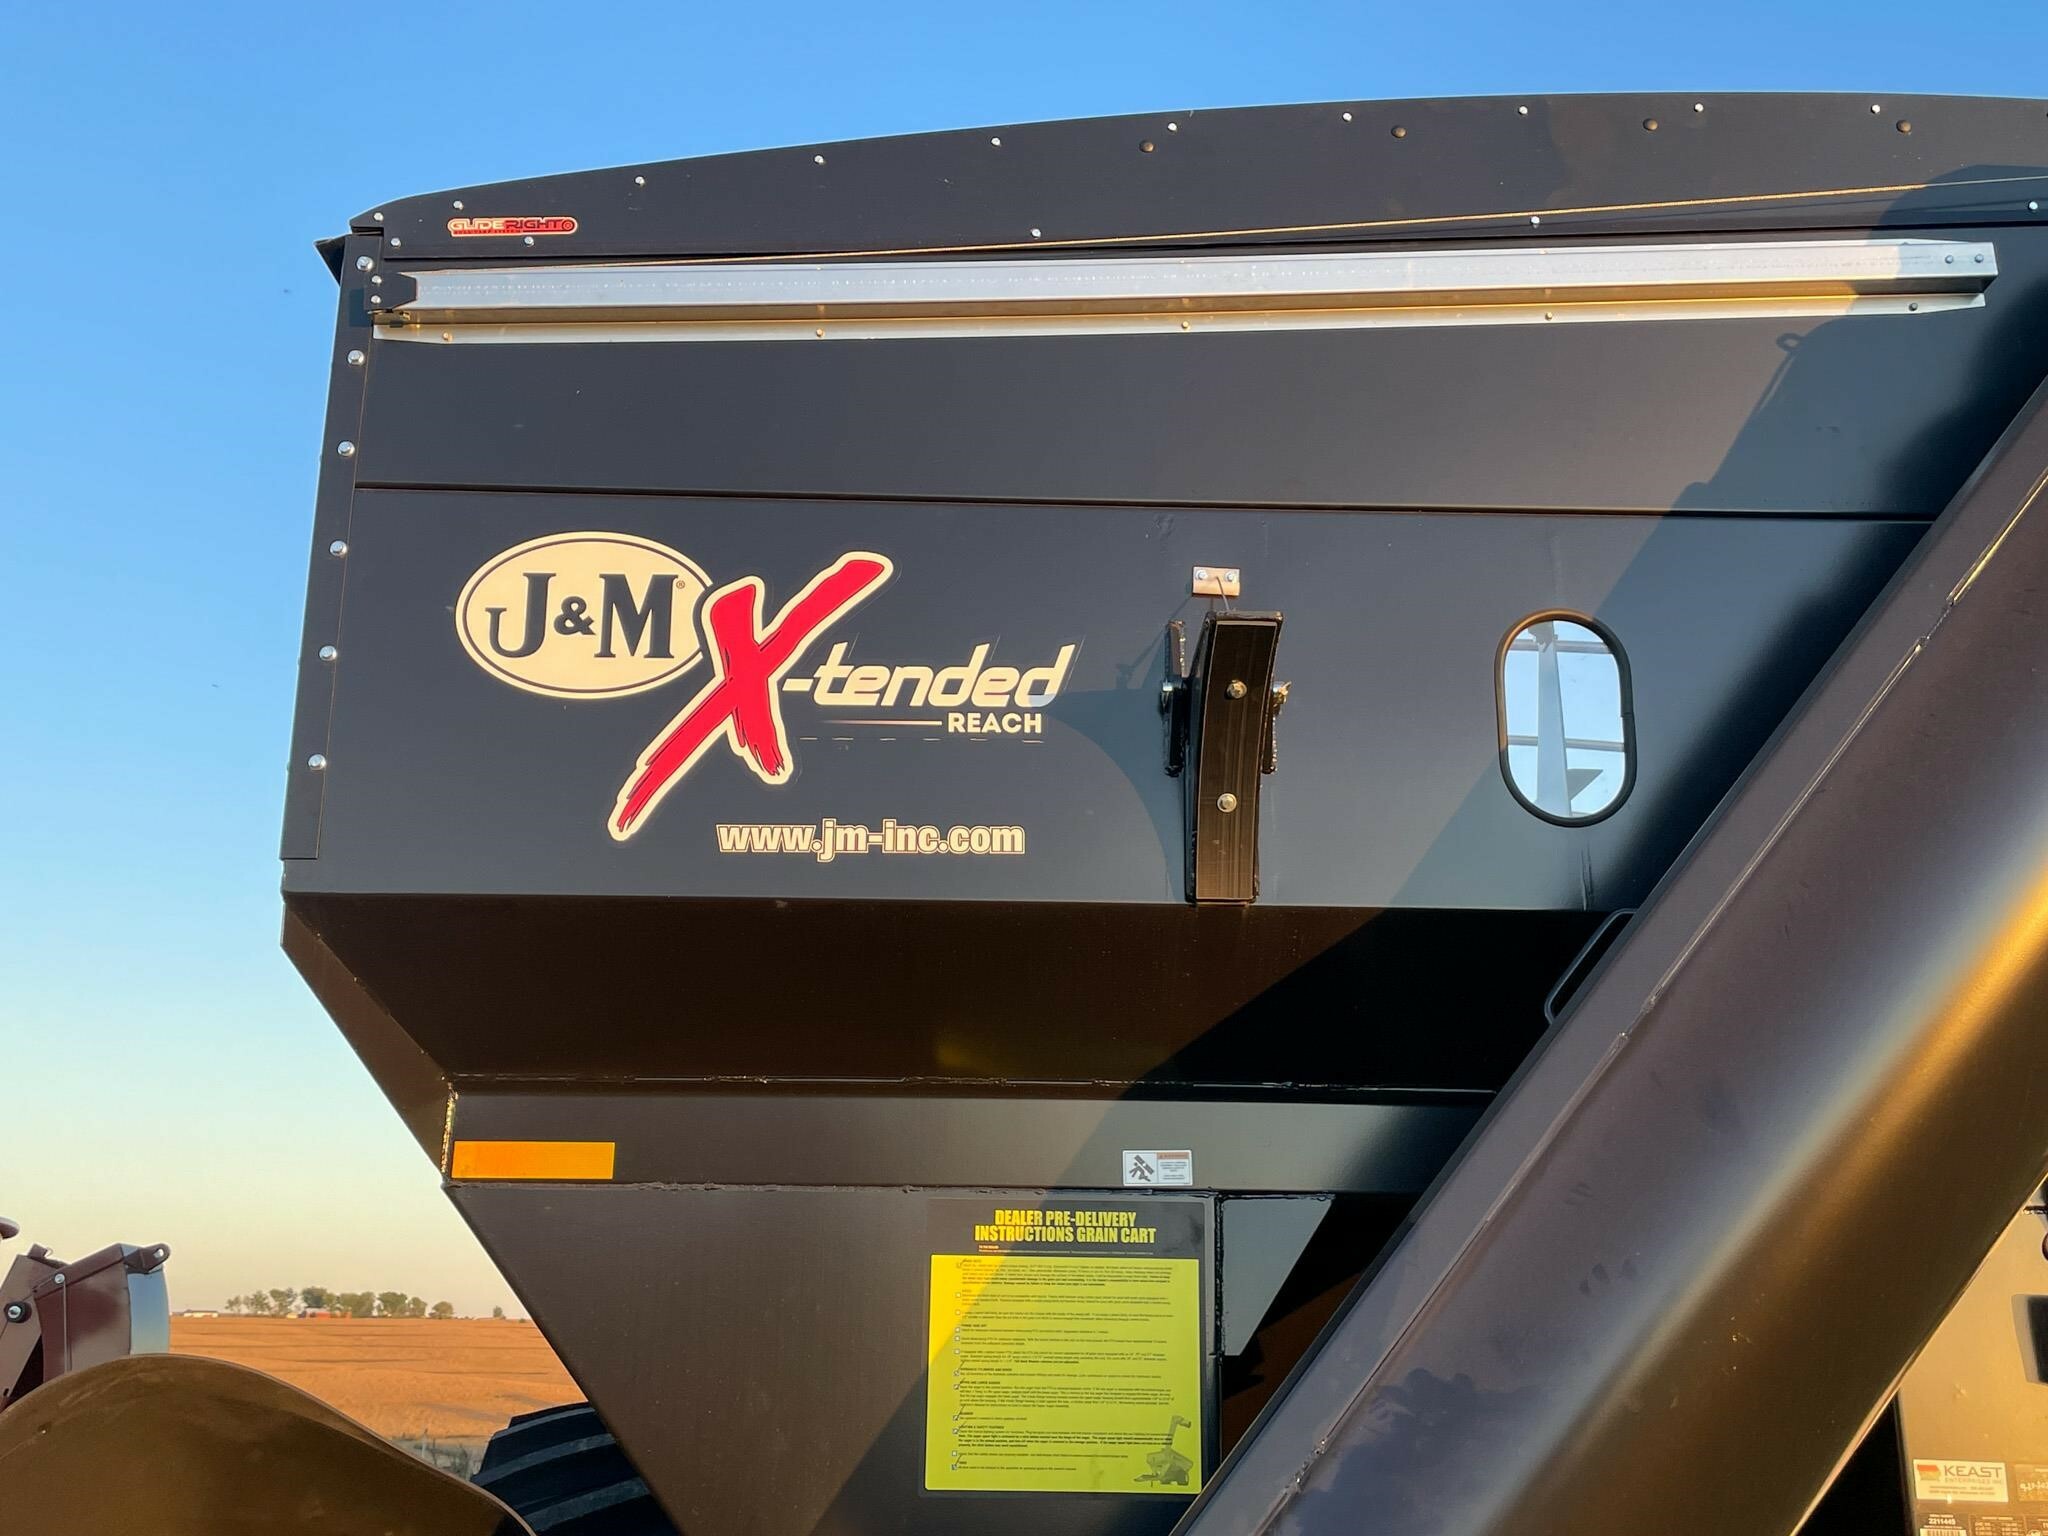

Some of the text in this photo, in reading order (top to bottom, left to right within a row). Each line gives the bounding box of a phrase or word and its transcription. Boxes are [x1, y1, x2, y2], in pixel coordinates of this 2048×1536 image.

[947, 713, 1043, 734] REACH
[716, 818, 1026, 863] www.jm-inc.com
[994, 1210, 1137, 1227] DEALER PRE-DELIVERY
[974, 1225, 1157, 1244] INSTRUCTIONS GRAIN CART
[1944, 1464, 2003, 1478] KEAST
